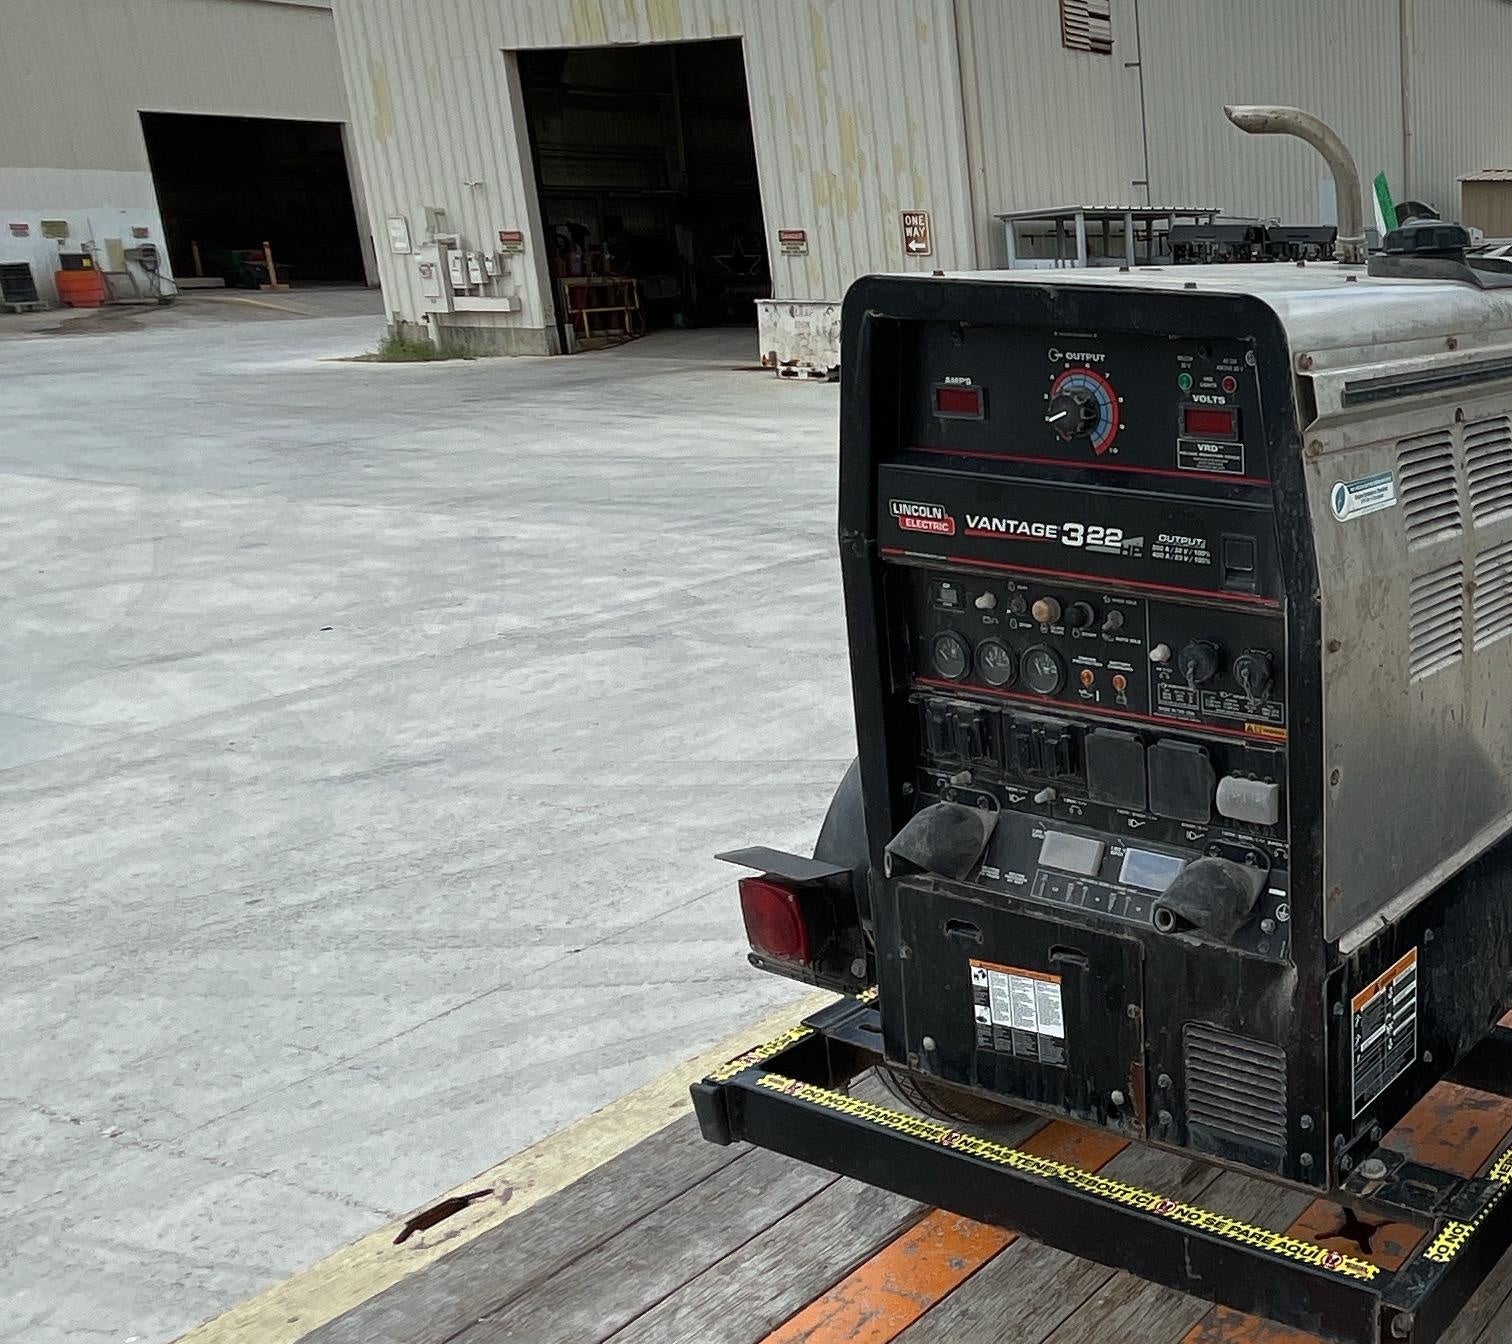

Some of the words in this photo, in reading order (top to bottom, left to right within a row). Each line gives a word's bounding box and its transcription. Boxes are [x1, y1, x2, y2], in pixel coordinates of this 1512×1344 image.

[904, 215, 925, 226] ONE
[905, 226, 926, 237] WAY
[1065, 352, 1106, 362] OUTPUT
[1192, 394, 1226, 405] VOLTS
[892, 503, 943, 519] LINCOLN
[904, 517, 950, 532] ELECTRIC
[964, 514, 1059, 540] VANTAGE
[1061, 522, 1124, 548] 322
[1158, 533, 1203, 545] OUTPUT
[802, 1088, 824, 1101] DO
[823, 1096, 856, 1111] NOT
[856, 1105, 902, 1124] STAND
[902, 1119, 942, 1138] HERE
[959, 1138, 981, 1150] NE
[981, 1145, 1011, 1161] PAS
[1063, 1168, 1131, 1198] DEBOUT
[1129, 1193, 1156, 1206] ICI
[1175, 1208, 1202, 1221] NO
[1202, 1216, 1223, 1229] SE
[1226, 1224, 1276, 1244] PARE
[1275, 1241, 1320, 1260] AQUI
[1444, 1226, 1465, 1244] NO
